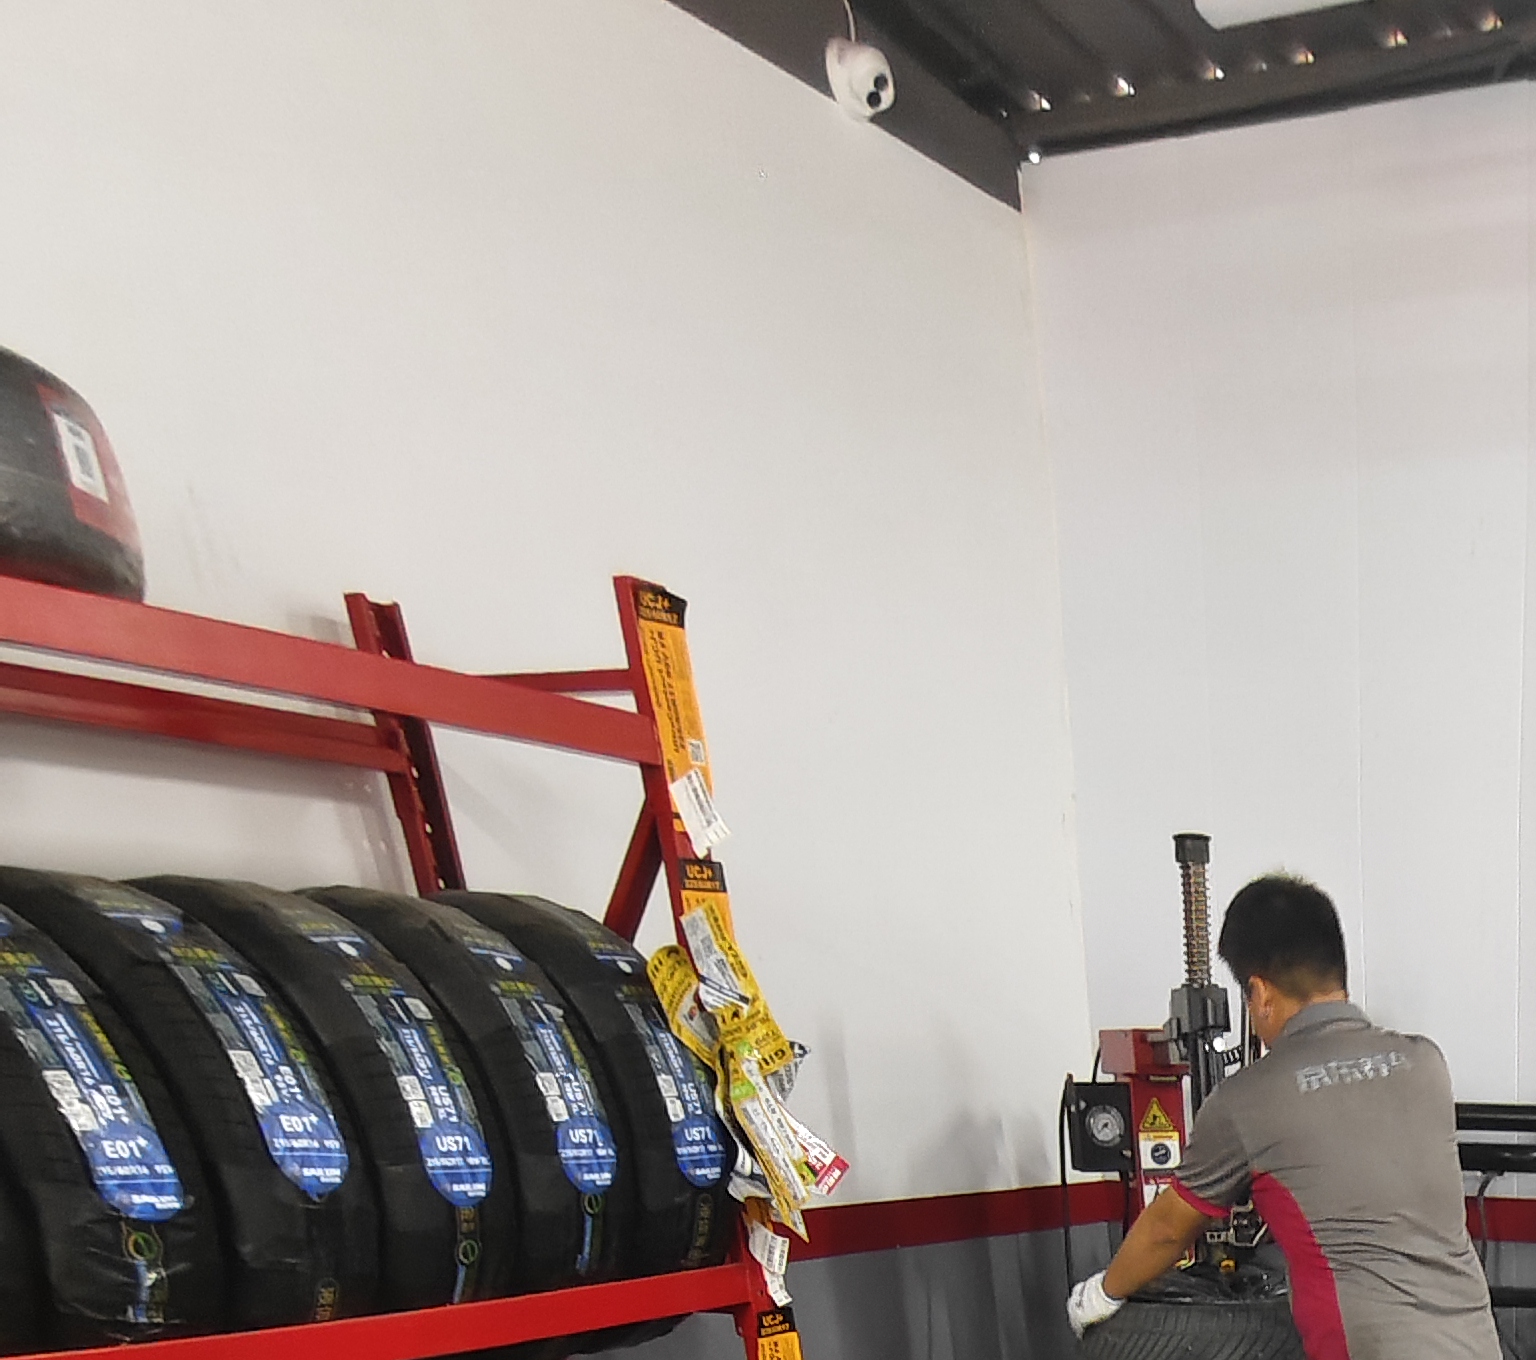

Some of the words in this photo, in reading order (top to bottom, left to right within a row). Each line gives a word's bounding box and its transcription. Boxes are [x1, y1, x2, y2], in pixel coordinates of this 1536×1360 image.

[279, 1112, 320, 1133] E01+
[435, 1135, 472, 1152] US71
[684, 1127, 713, 1142] US71
[101, 1134, 150, 1160] E01+
